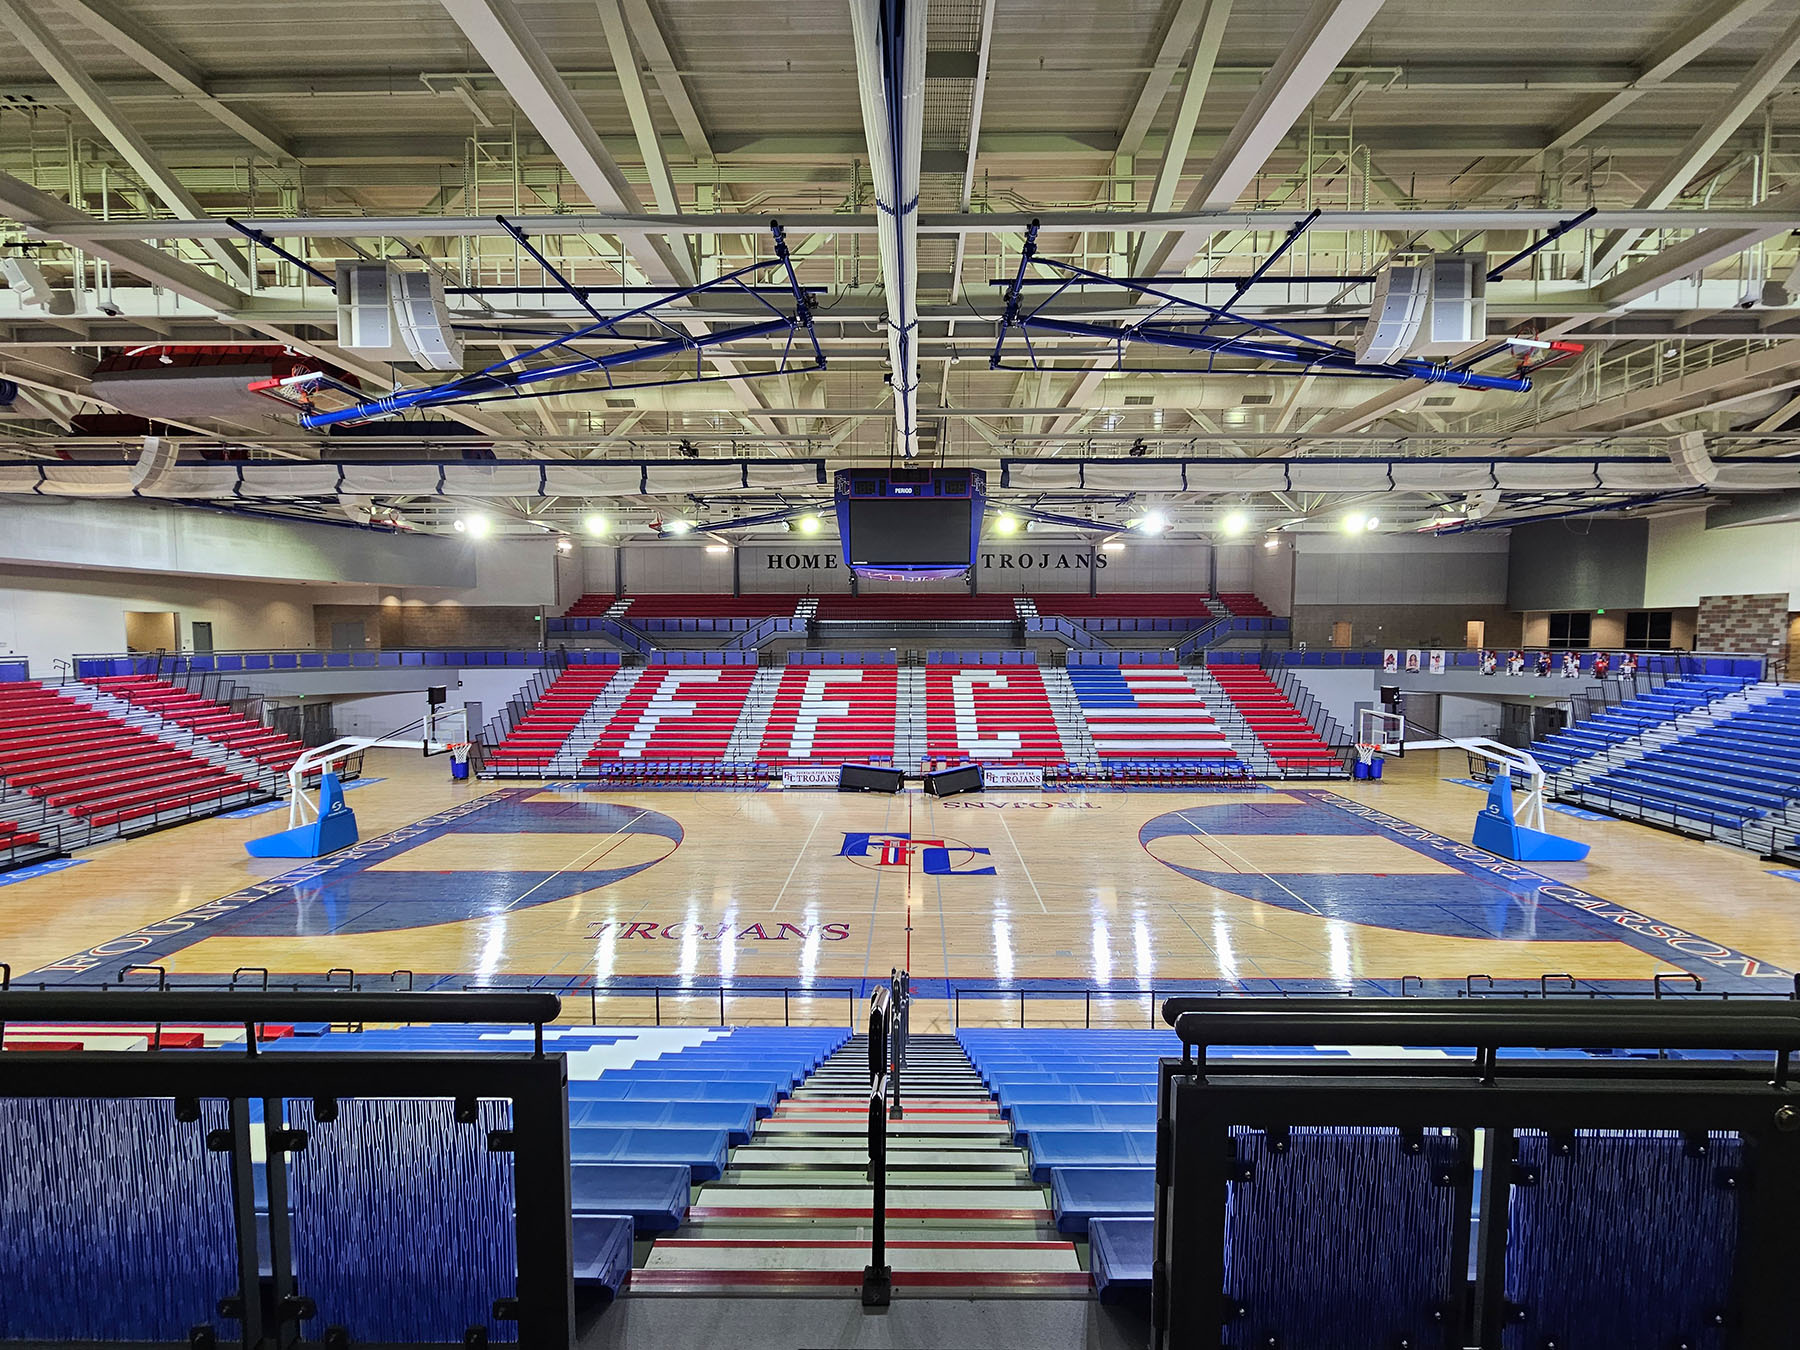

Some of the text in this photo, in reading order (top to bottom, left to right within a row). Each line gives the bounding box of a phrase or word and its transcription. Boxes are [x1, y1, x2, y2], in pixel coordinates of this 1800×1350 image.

[767, 554, 838, 569] HOME
[981, 553, 1107, 569] TROJANS
[796, 774, 840, 783] TROJANS
[1000, 775, 1041, 783] TROJANS
[943, 801, 1102, 809] TROJANS
[583, 921, 851, 941] TROJANS
[1537, 885, 1797, 979] CARSON
